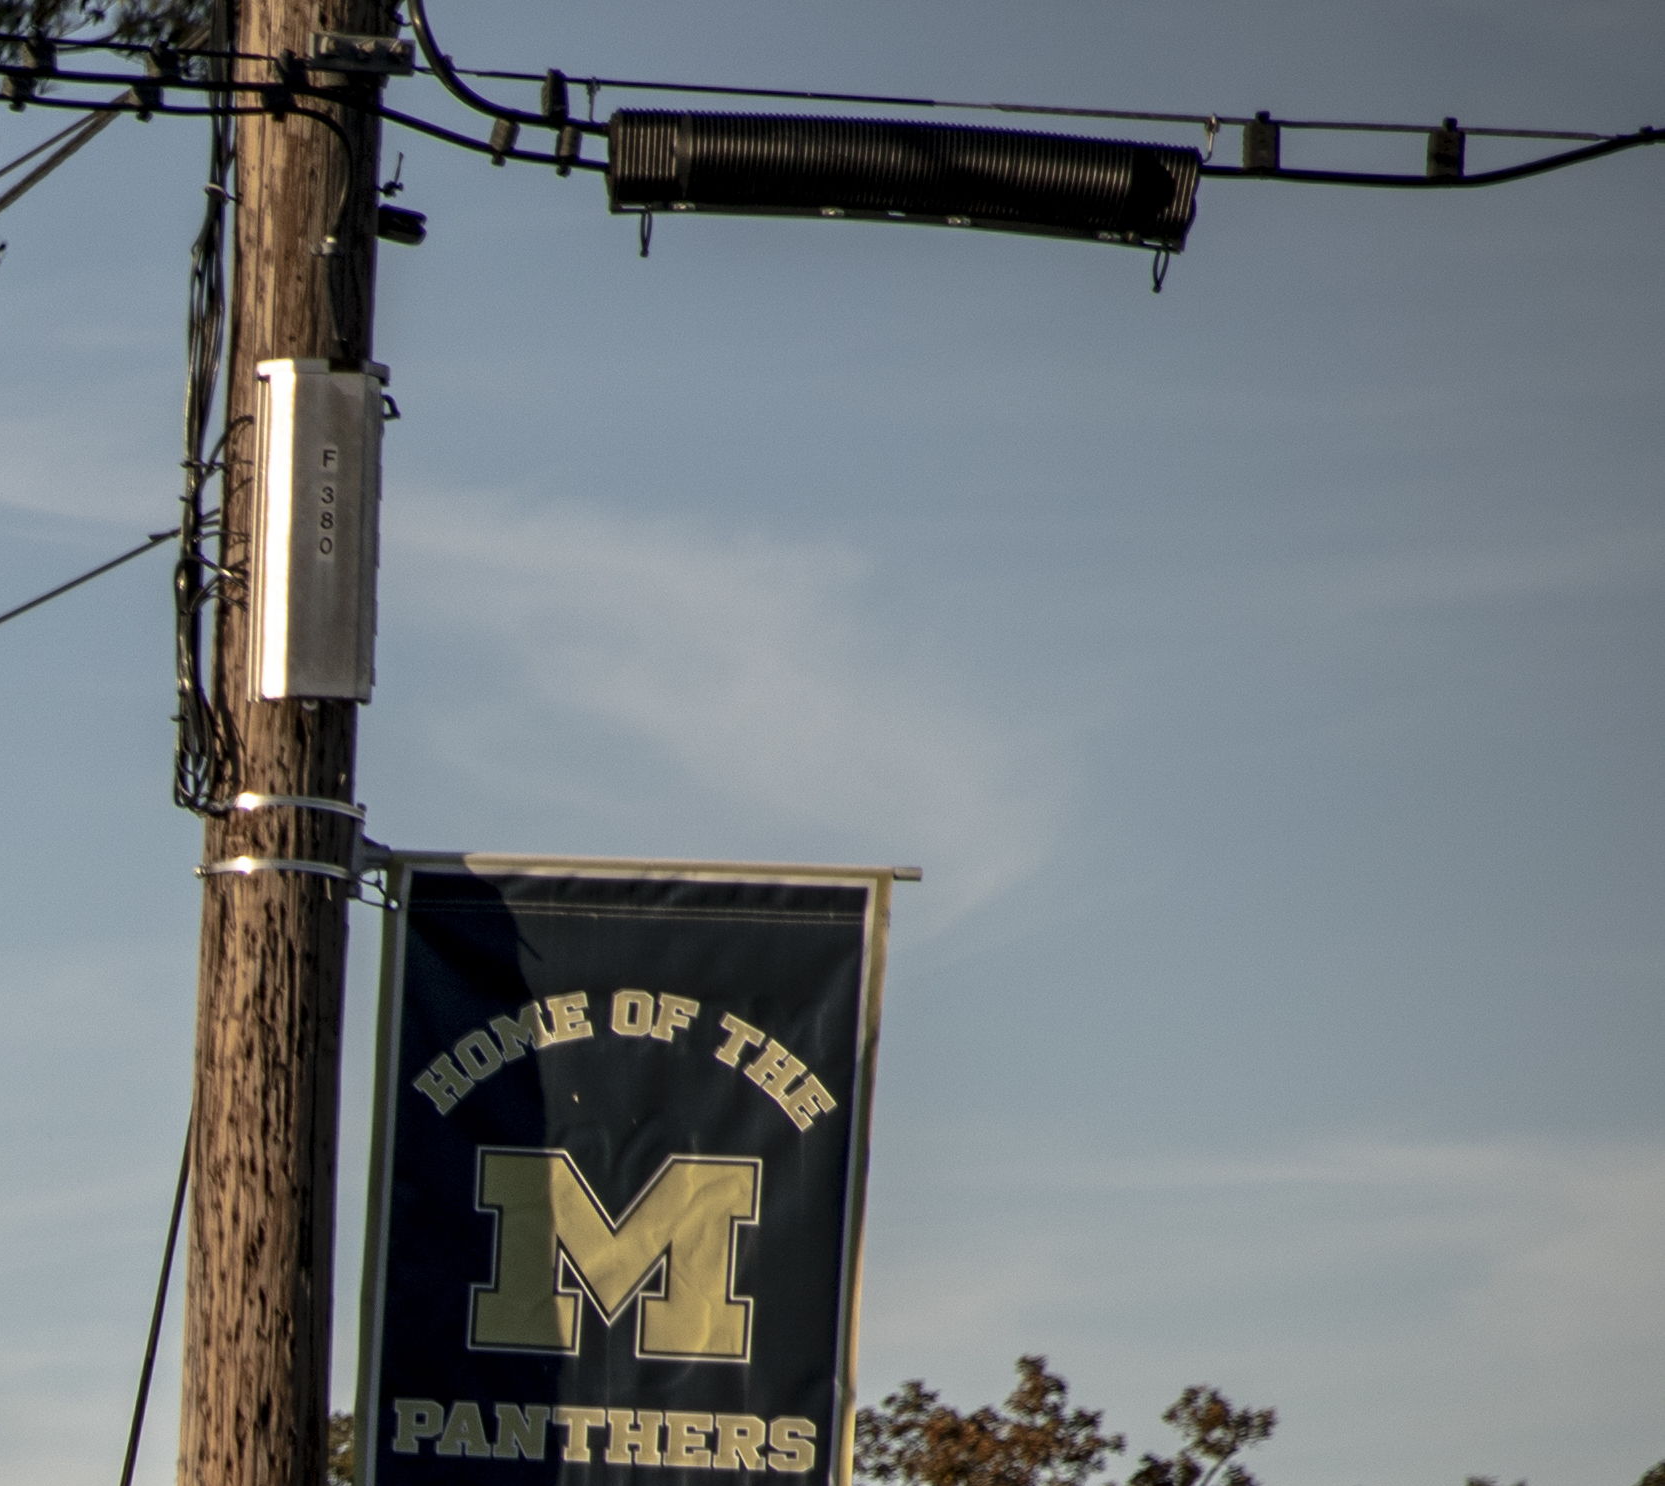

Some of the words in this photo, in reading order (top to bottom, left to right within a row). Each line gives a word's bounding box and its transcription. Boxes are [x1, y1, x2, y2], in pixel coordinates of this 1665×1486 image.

[412, 990, 594, 1115] HOME
[611, 988, 701, 1042] OF
[715, 1012, 838, 1132] THE
[467, 1145, 763, 1363] M
[392, 1398, 817, 1473] PANTHERS
